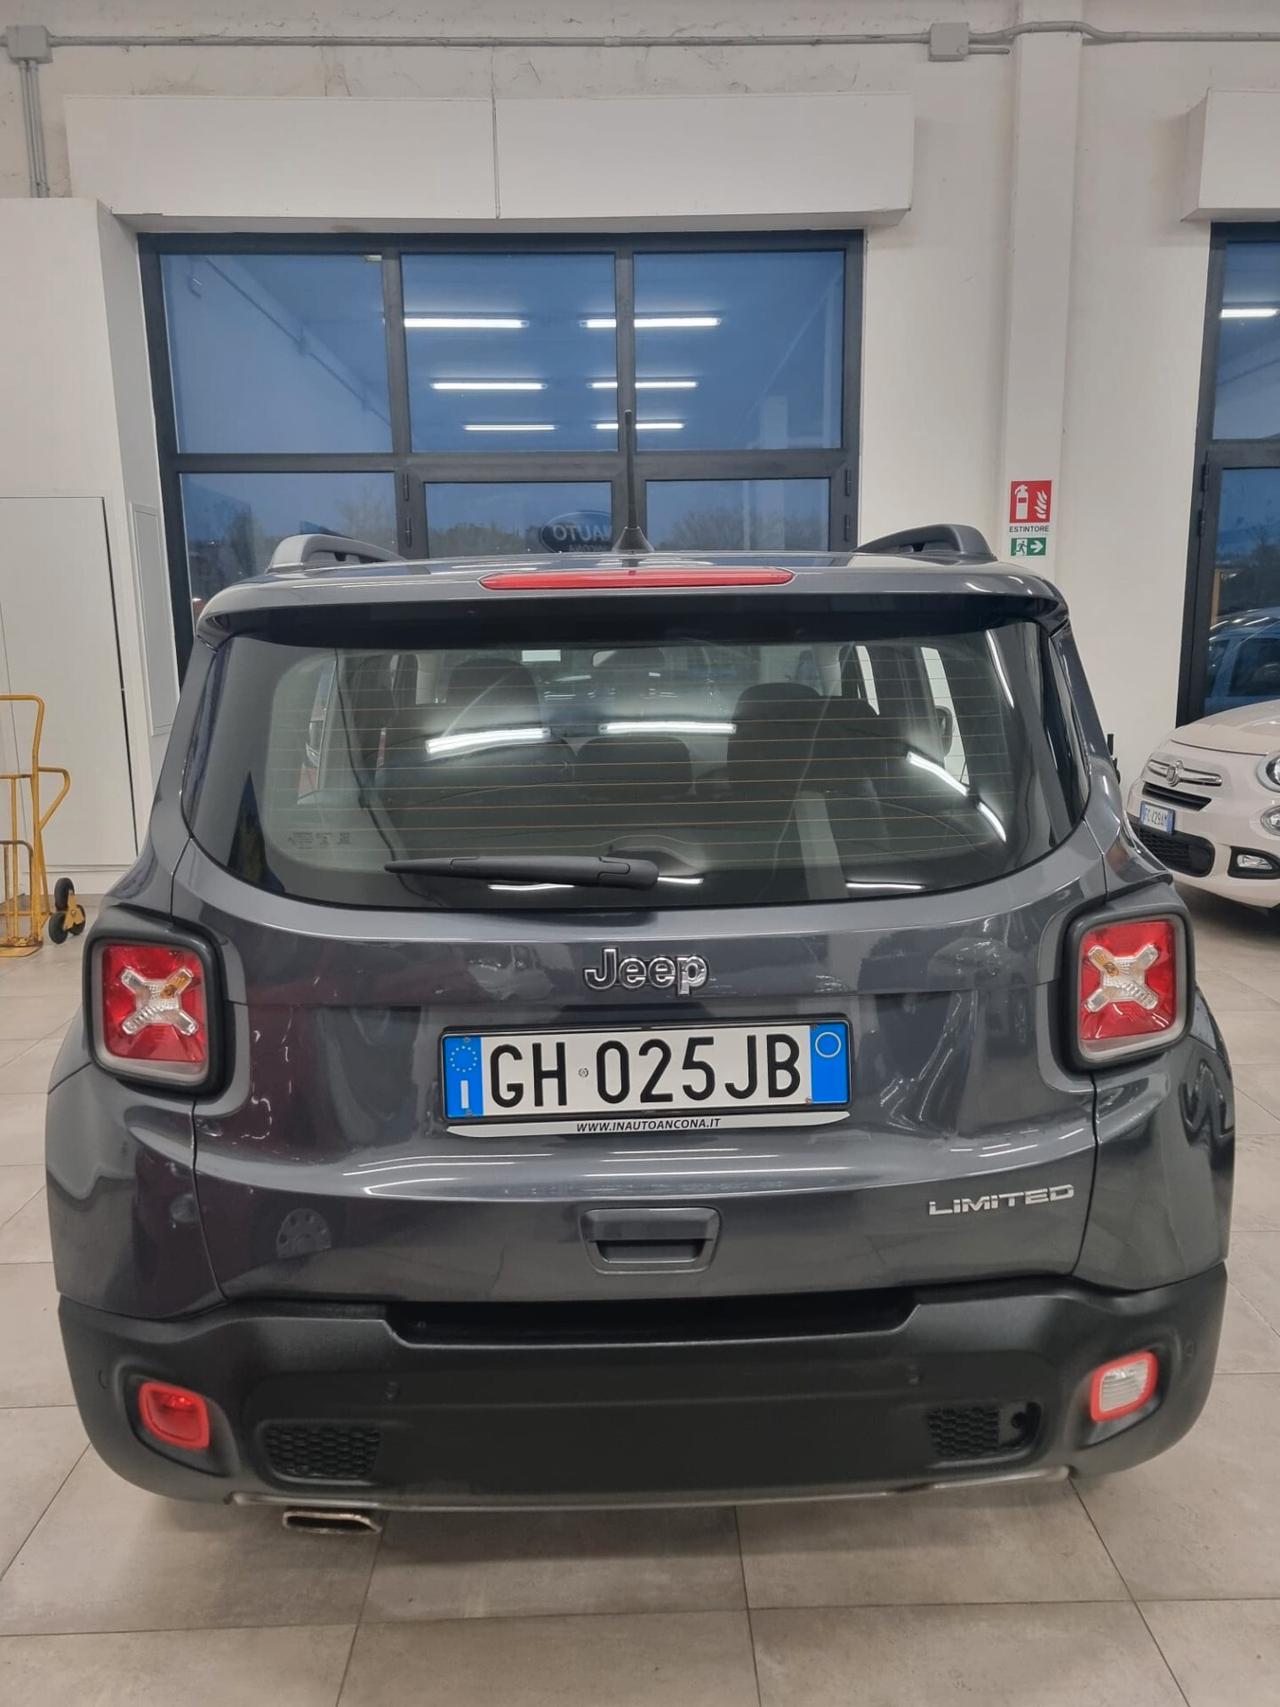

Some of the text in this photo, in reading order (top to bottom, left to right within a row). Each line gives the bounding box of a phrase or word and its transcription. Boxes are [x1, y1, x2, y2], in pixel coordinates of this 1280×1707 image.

[1009, 525, 1049, 533] ESTINTORE
[583, 948, 708, 995] Jeep
[490, 1033, 801, 1108] GH 025JB
[576, 1118, 721, 1132] WWW.INAUTOANCONA.IT
[929, 1184, 1075, 1215] LIMITED
